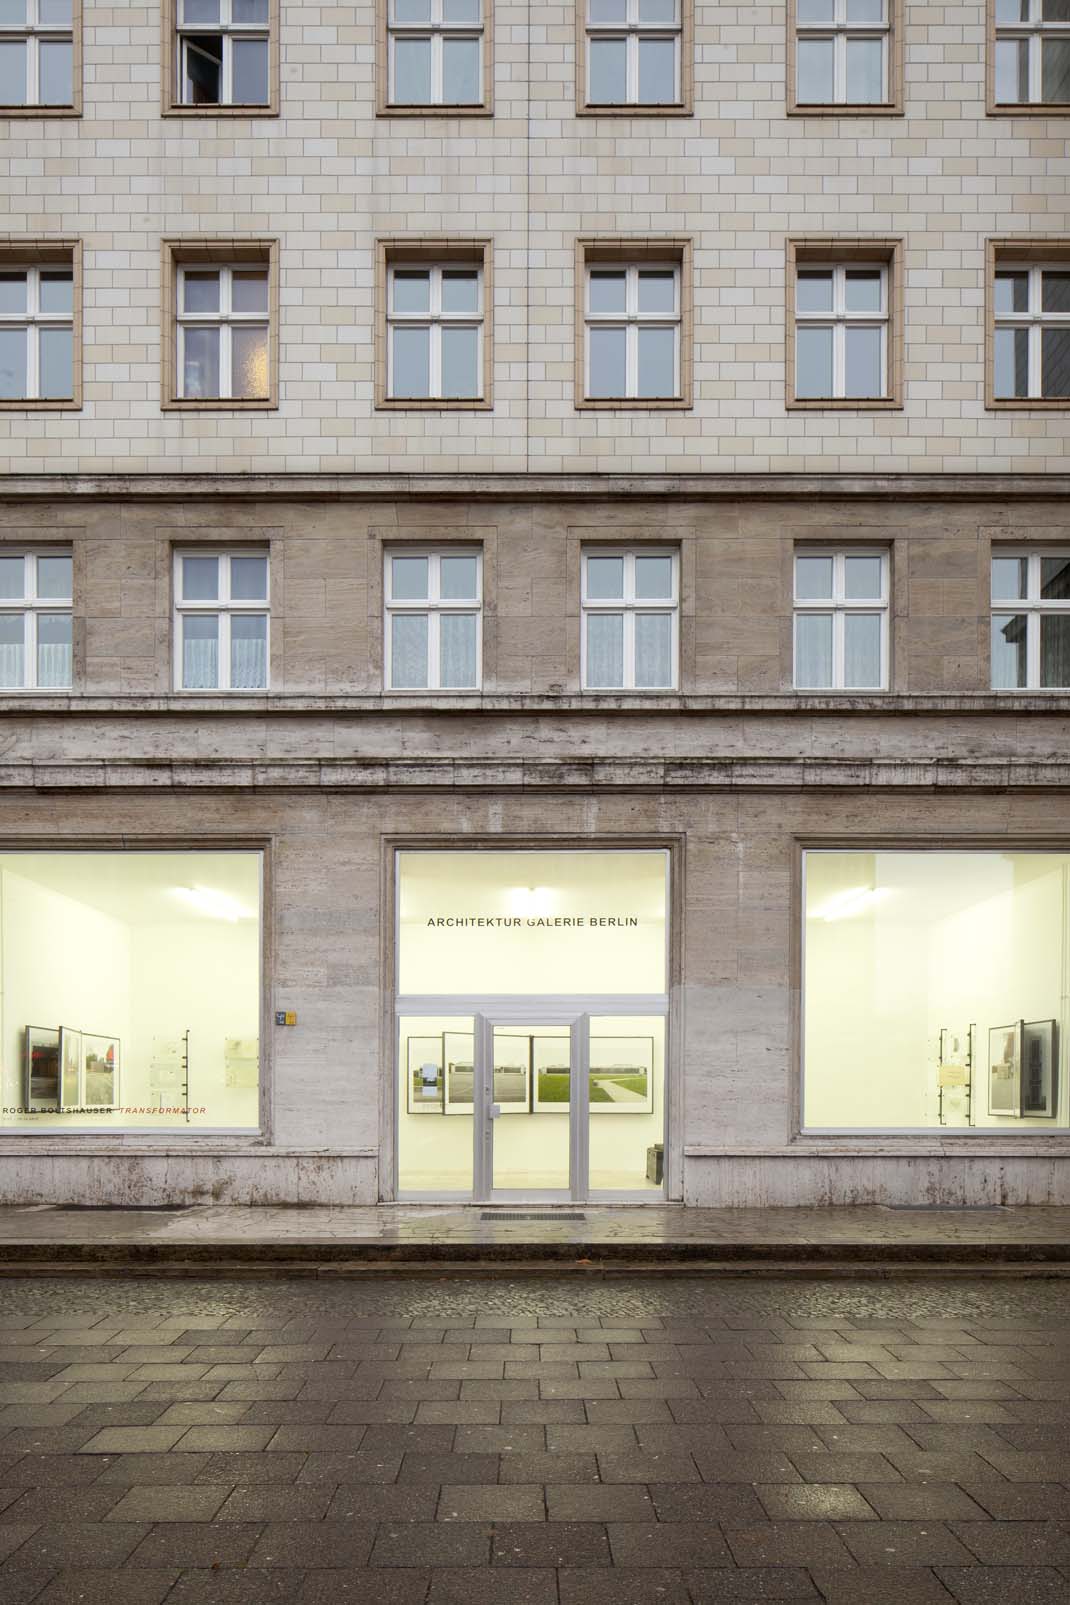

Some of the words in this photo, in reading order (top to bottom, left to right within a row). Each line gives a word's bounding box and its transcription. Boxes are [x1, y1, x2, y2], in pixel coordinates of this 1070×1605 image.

[427, 917, 522, 927] ARCHITEKTUR
[527, 917, 584, 927] GALERIE
[590, 917, 638, 927] BERLIN
[2, 1107, 37, 1115] ROGER
[119, 1107, 207, 1115] TRANSFORMATOR
